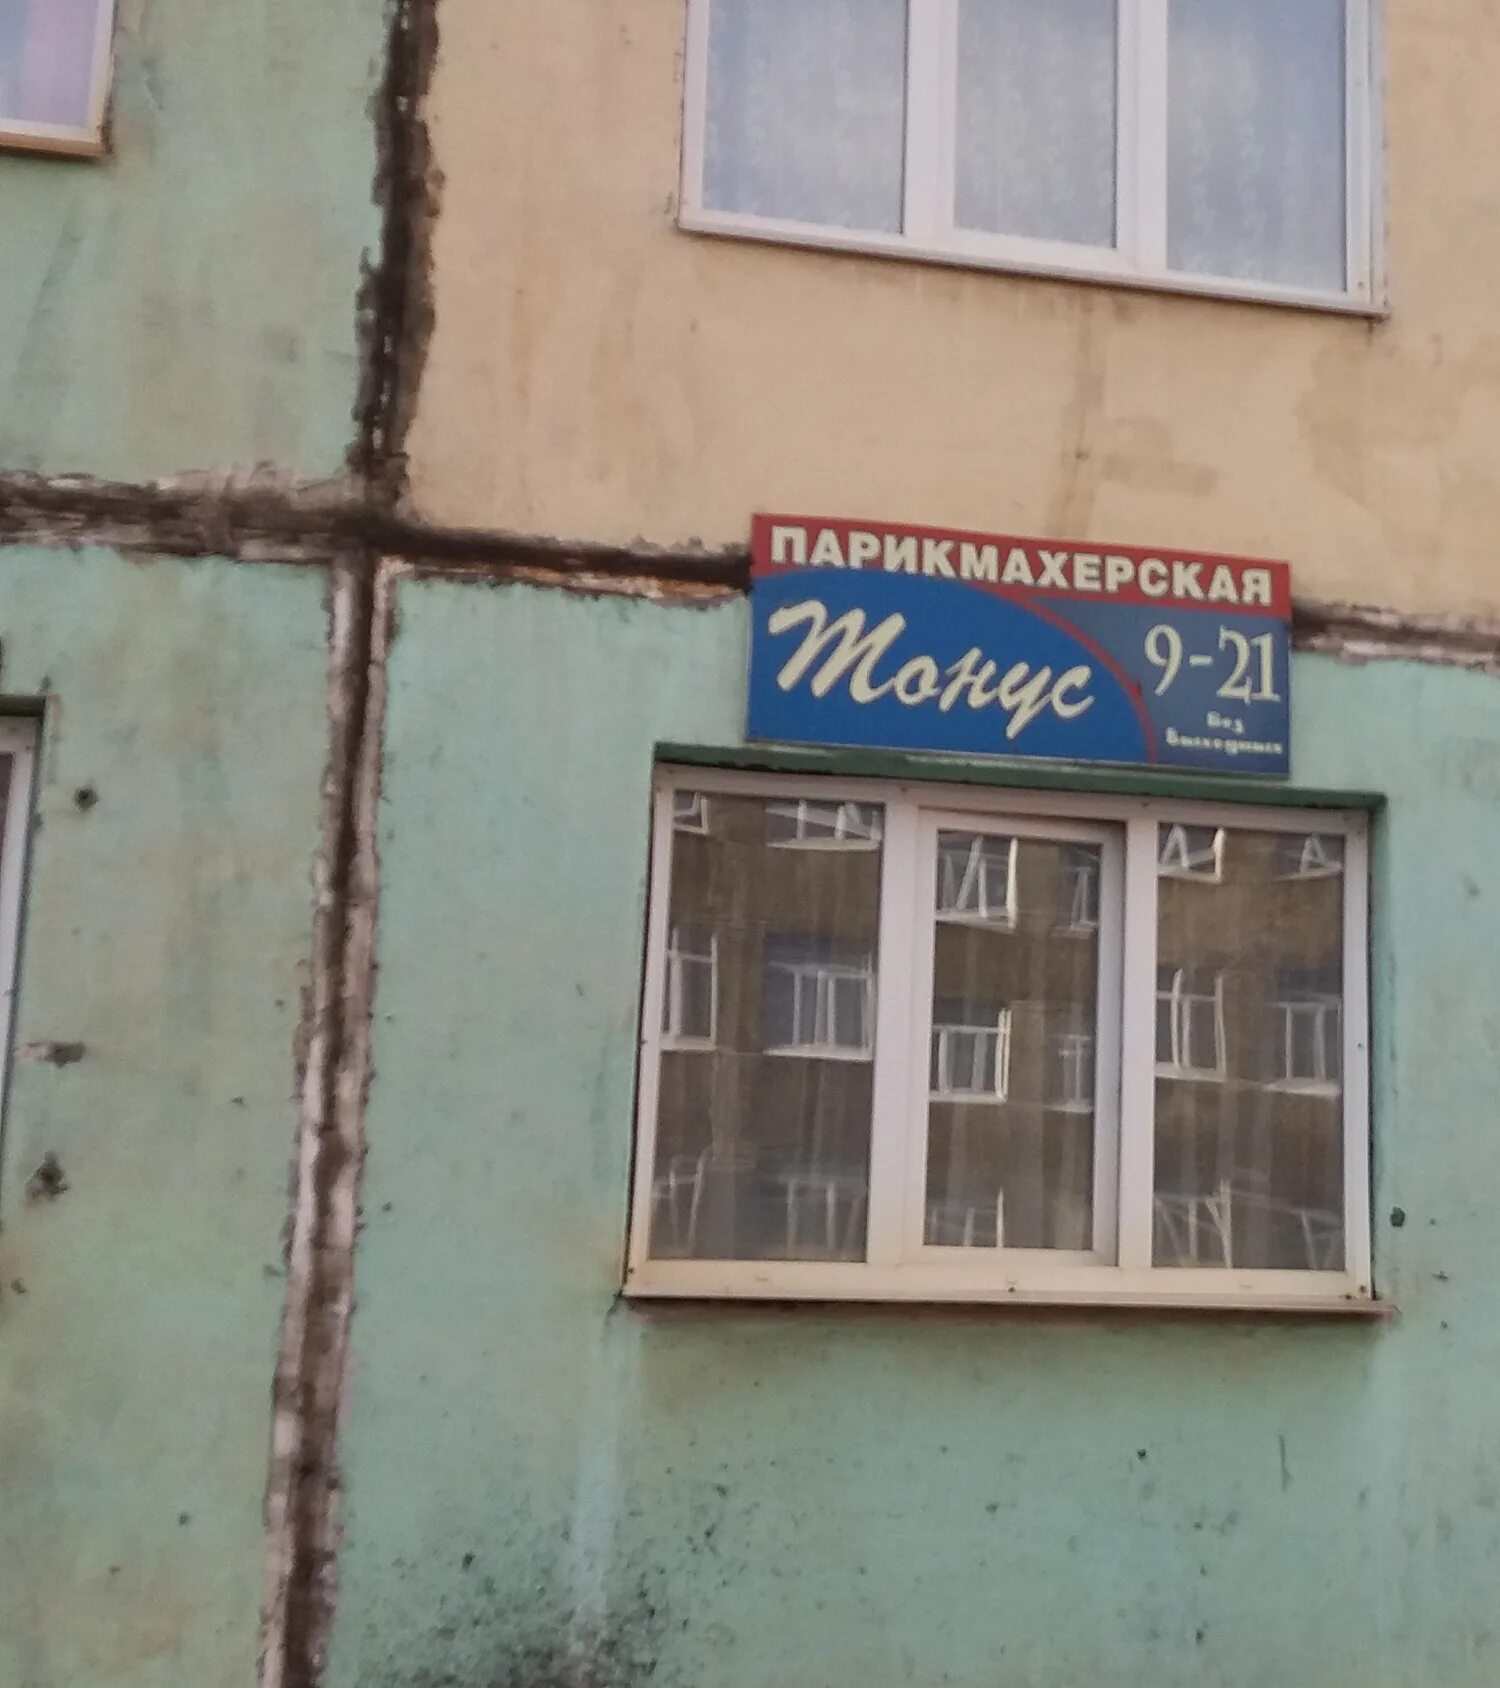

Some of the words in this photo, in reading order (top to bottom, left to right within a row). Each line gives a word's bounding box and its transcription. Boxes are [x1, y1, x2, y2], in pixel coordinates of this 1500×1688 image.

[770, 526, 1273, 607] ПАРИКМАХЕРСКАЯ
[768, 600, 1095, 739] Тонус
[1144, 624, 1280, 705] 9-21
